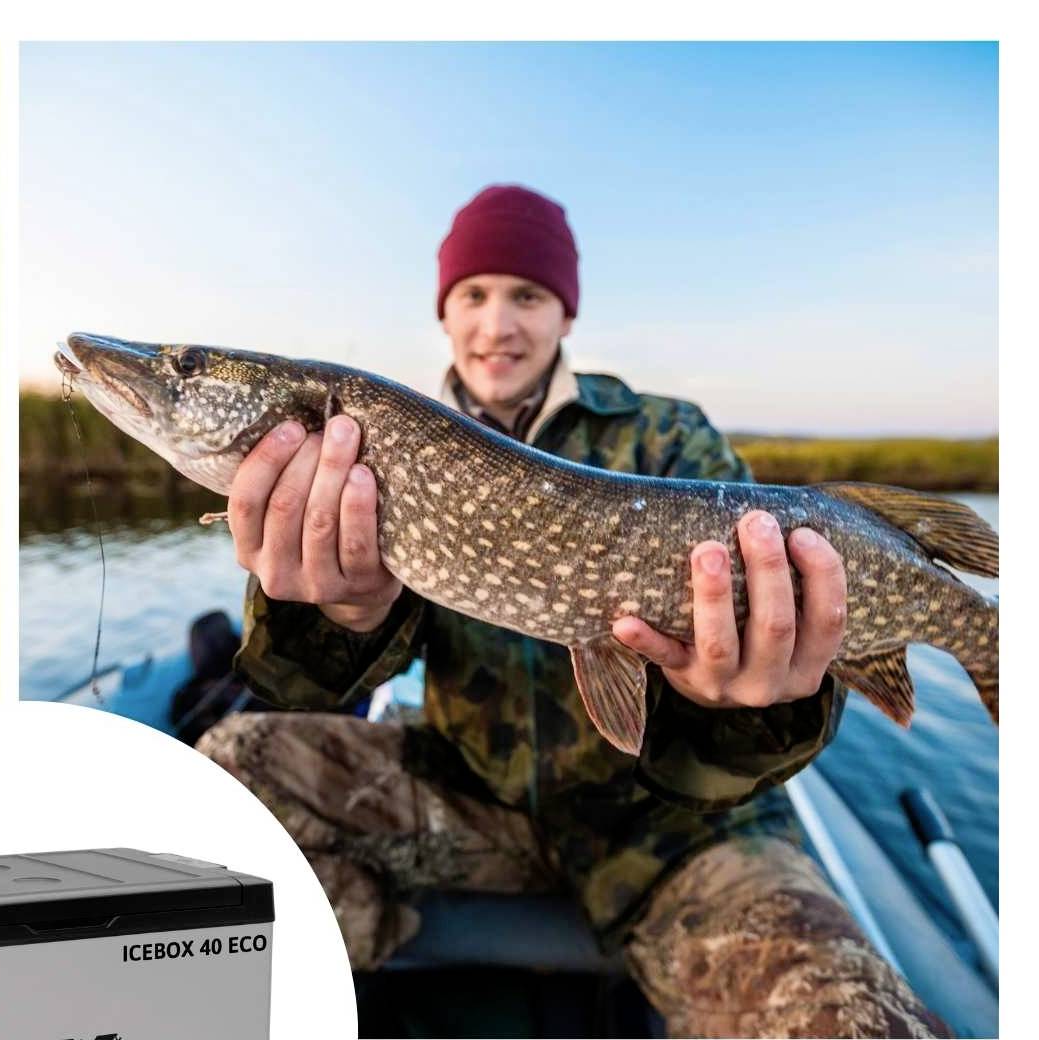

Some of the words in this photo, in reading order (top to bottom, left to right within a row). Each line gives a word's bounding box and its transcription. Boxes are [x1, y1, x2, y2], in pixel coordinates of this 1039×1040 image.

[123, 940, 195, 962] ICEBOX
[199, 938, 223, 956] 40
[228, 934, 267, 954] ECO
